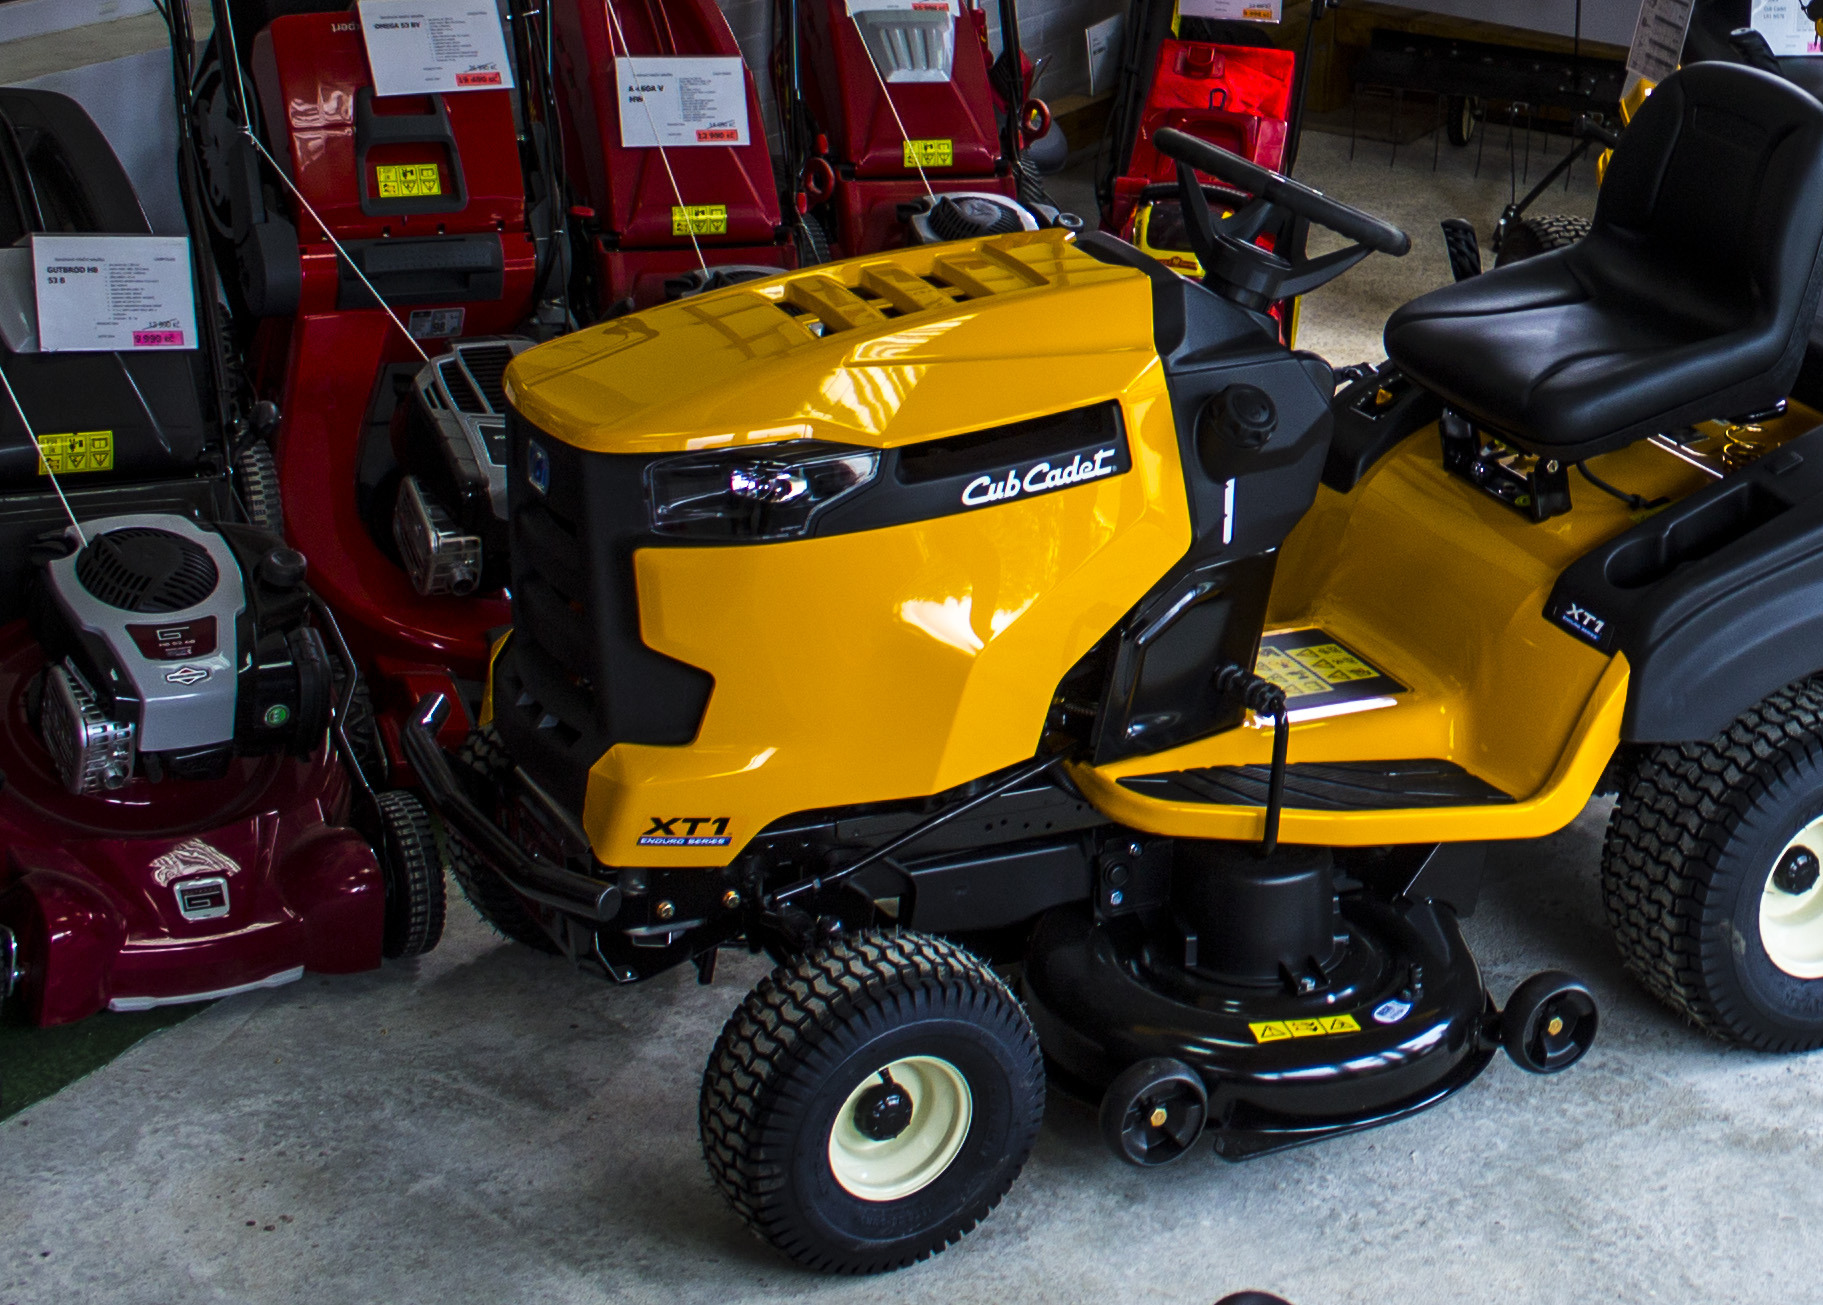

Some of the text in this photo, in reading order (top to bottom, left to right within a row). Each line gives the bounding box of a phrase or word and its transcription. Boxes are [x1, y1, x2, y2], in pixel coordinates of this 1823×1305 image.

[47, 266, 86, 274] GUTBROD
[961, 448, 1115, 506] Cub Cadet
[1566, 602, 1605, 634] XT1
[641, 817, 731, 836] XT1
[640, 837, 726, 845] ENDURO SERIES
